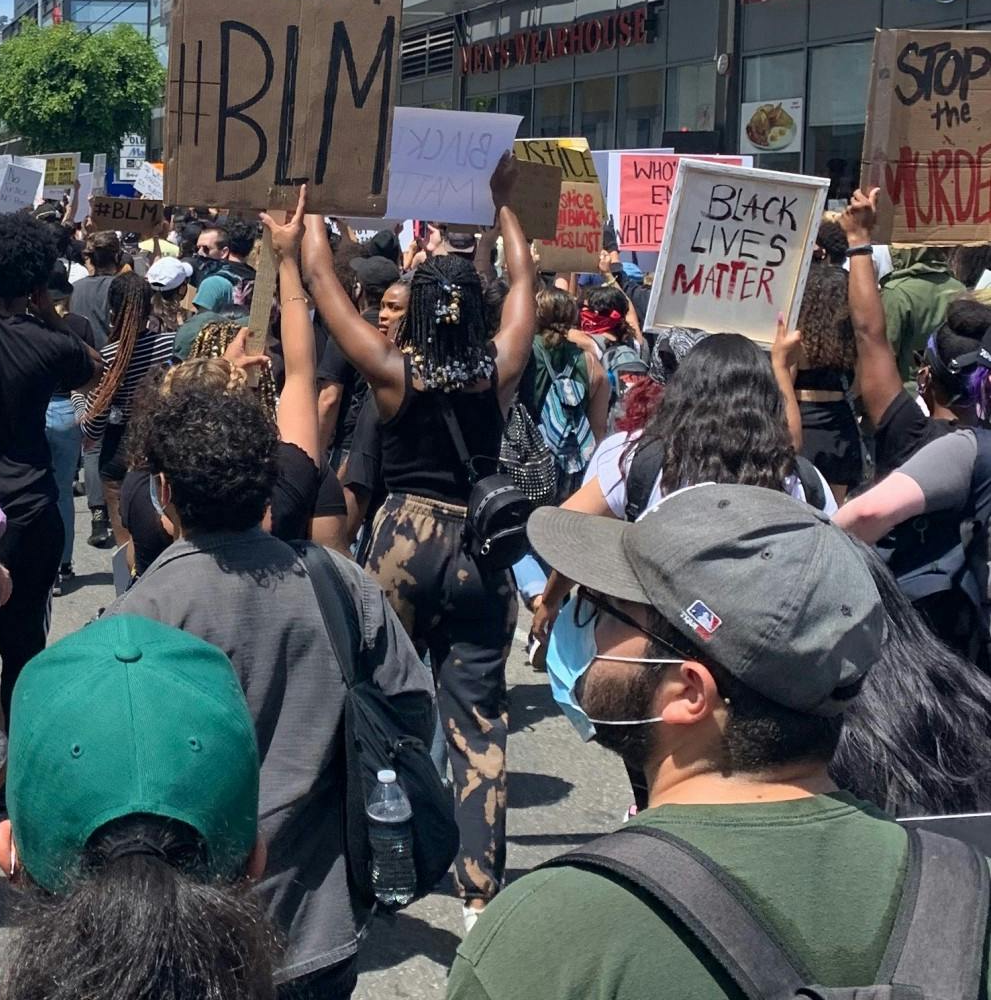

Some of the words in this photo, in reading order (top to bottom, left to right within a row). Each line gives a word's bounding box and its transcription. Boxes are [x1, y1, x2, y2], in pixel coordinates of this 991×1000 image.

[513, 8, 648, 65] WEARHOUSE
[894, 41, 991, 106] STOP
[170, 15, 395, 195] #BLM
[930, 101, 973, 130] the
[94, 201, 158, 224] #BLM
[701, 184, 798, 232] BLACK
[690, 222, 788, 267] LIVES
[671, 260, 775, 304] MATTER
